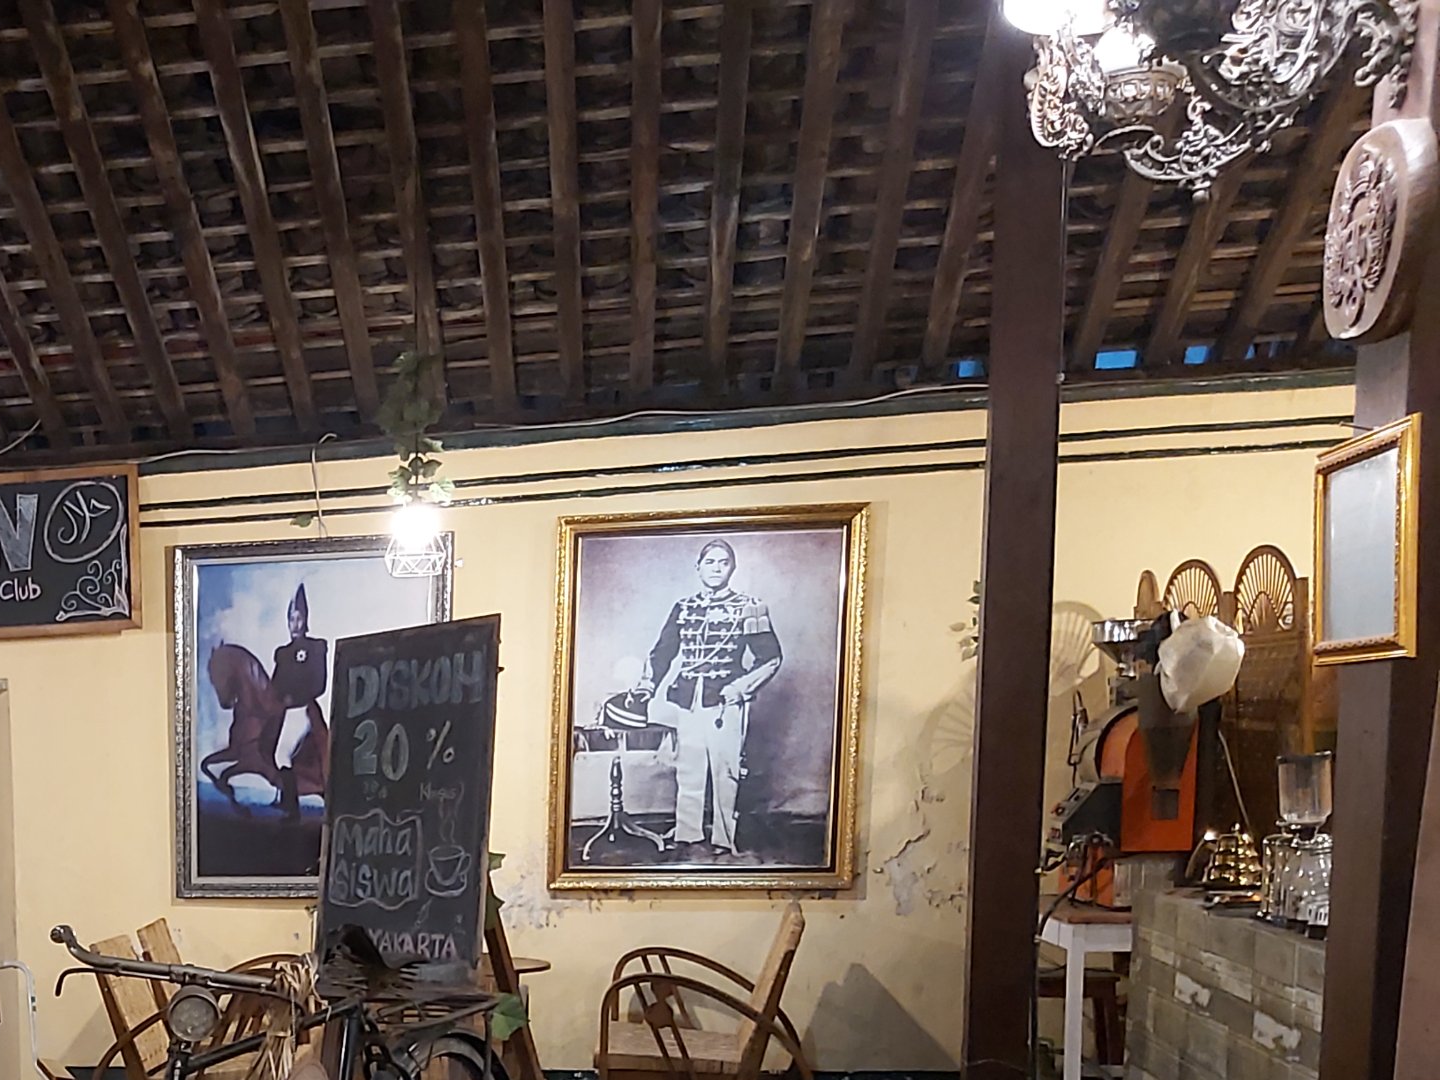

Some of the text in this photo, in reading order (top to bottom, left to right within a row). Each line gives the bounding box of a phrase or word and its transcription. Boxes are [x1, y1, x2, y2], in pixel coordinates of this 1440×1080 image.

[0, 576, 42, 602] Club
[353, 719, 455, 781] 20 %
[337, 815, 412, 857] Maha
